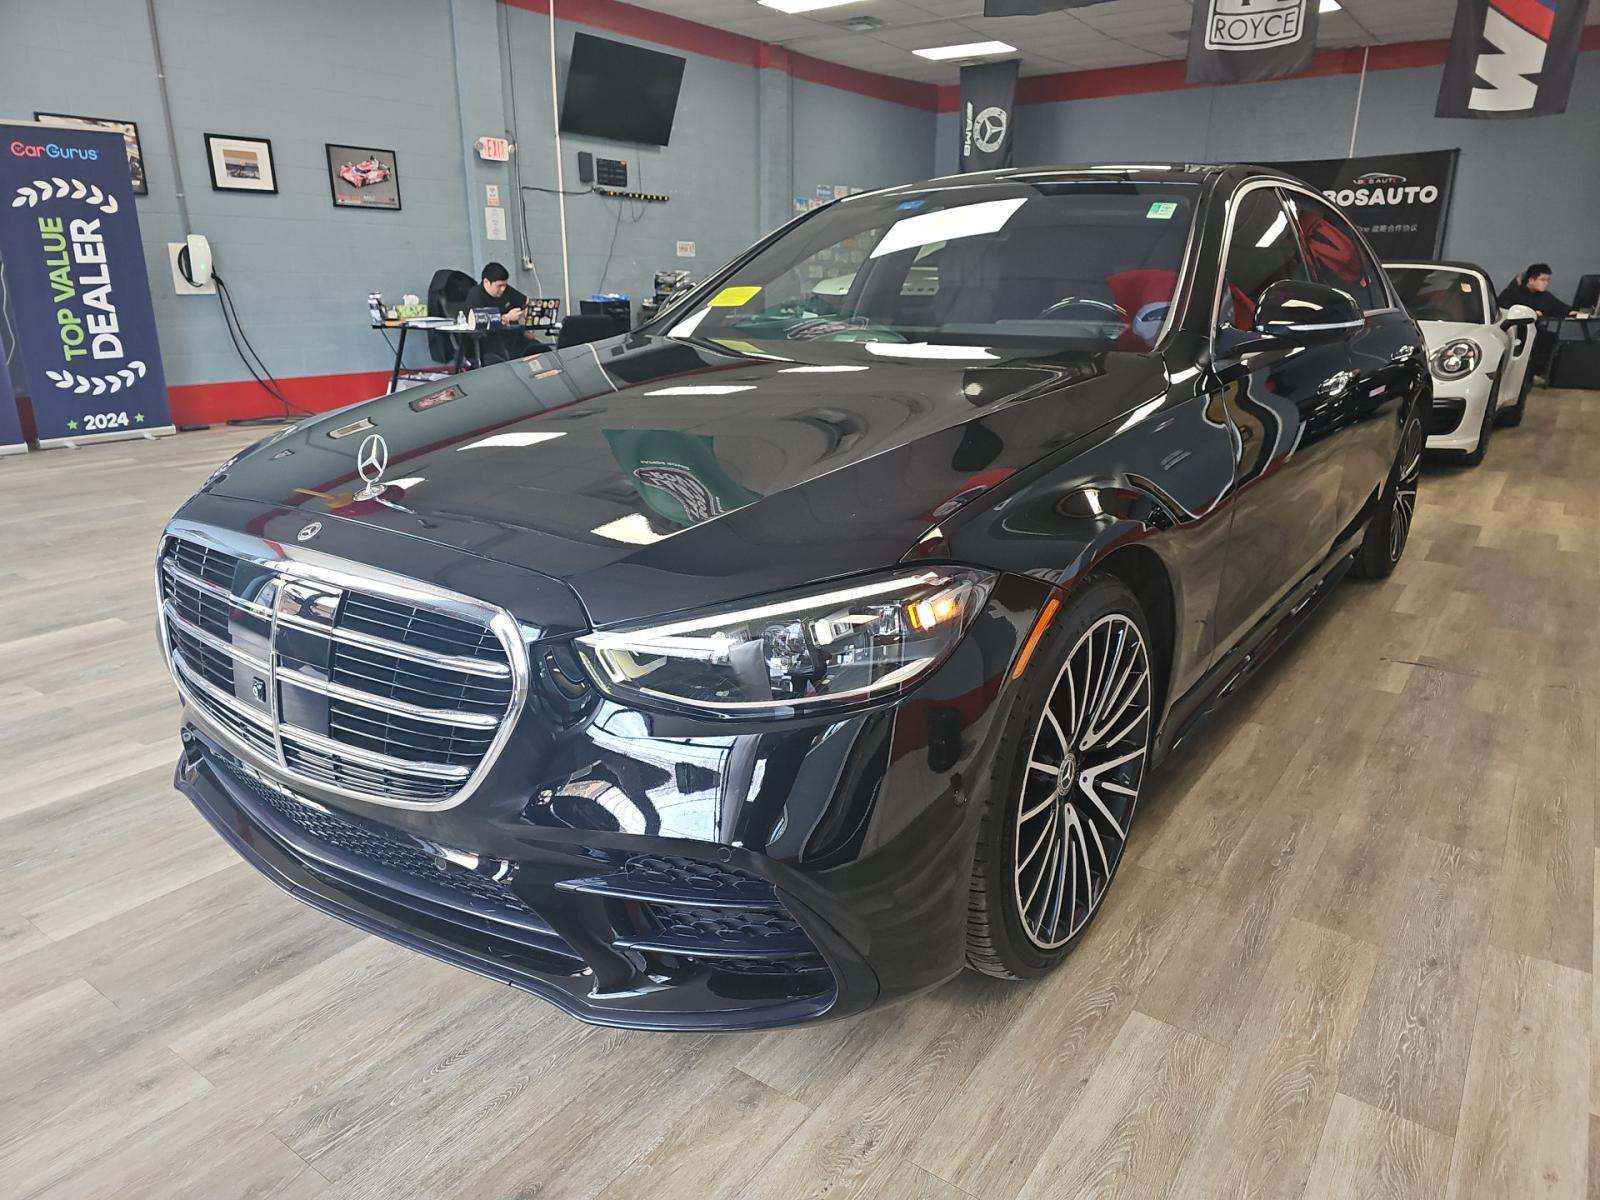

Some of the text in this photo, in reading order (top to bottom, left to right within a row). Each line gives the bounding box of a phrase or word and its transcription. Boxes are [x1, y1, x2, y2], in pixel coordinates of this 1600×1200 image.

[1214, 11, 1296, 40] ROYCE
[10, 140, 98, 161] CarGurus
[486, 138, 506, 159] EXIT
[38, 217, 88, 362] TOP VALUE
[69, 218, 125, 360] DEALER
[83, 411, 130, 431] 2024
